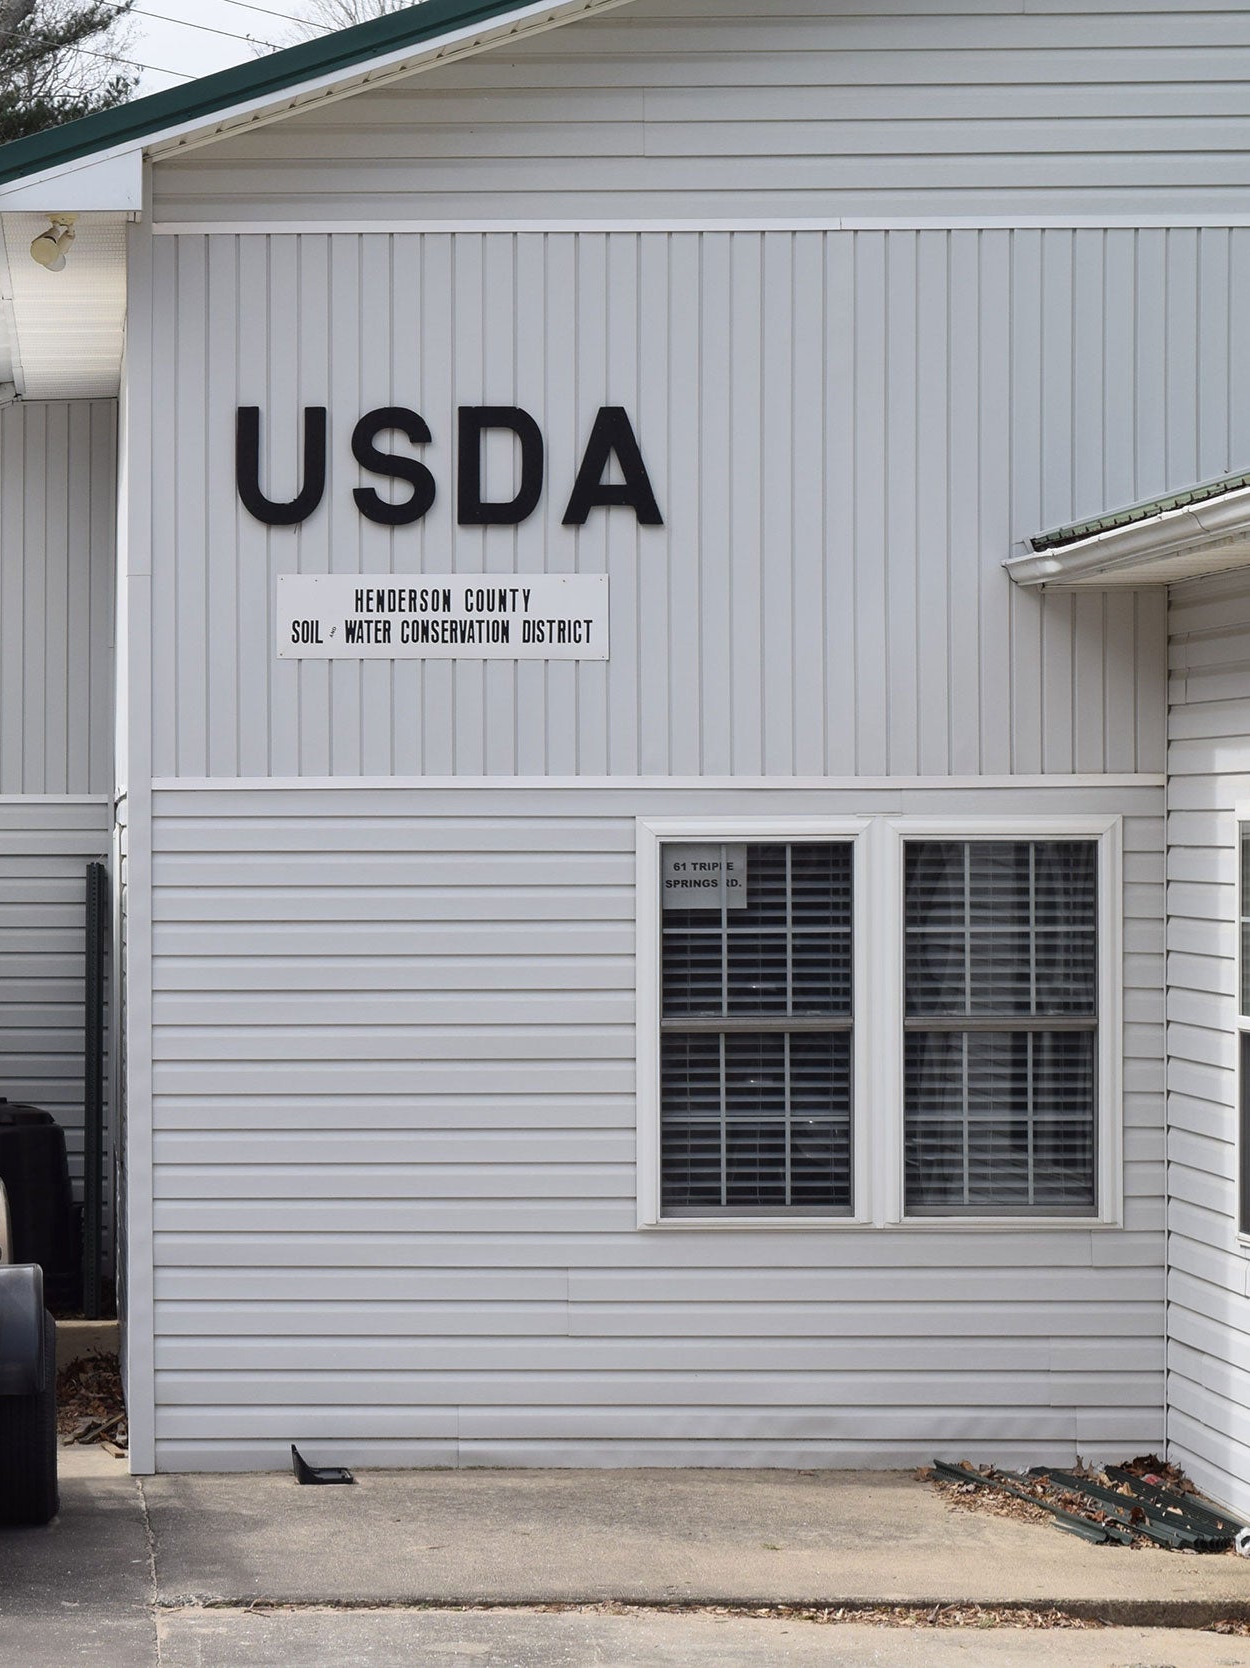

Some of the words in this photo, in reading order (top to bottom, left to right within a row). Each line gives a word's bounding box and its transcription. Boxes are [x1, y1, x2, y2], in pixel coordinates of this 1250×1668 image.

[236, 406, 664, 526] USDA
[354, 588, 451, 613] HENDERSON
[464, 588, 531, 613] COUNTY
[291, 619, 323, 644] SOIL
[344, 619, 392, 644] WATER
[400, 619, 510, 644] CONSERVATION
[522, 619, 593, 644] DISTRICT
[673, 862, 686, 871] 61
[665, 879, 718, 888] SPRINGS
